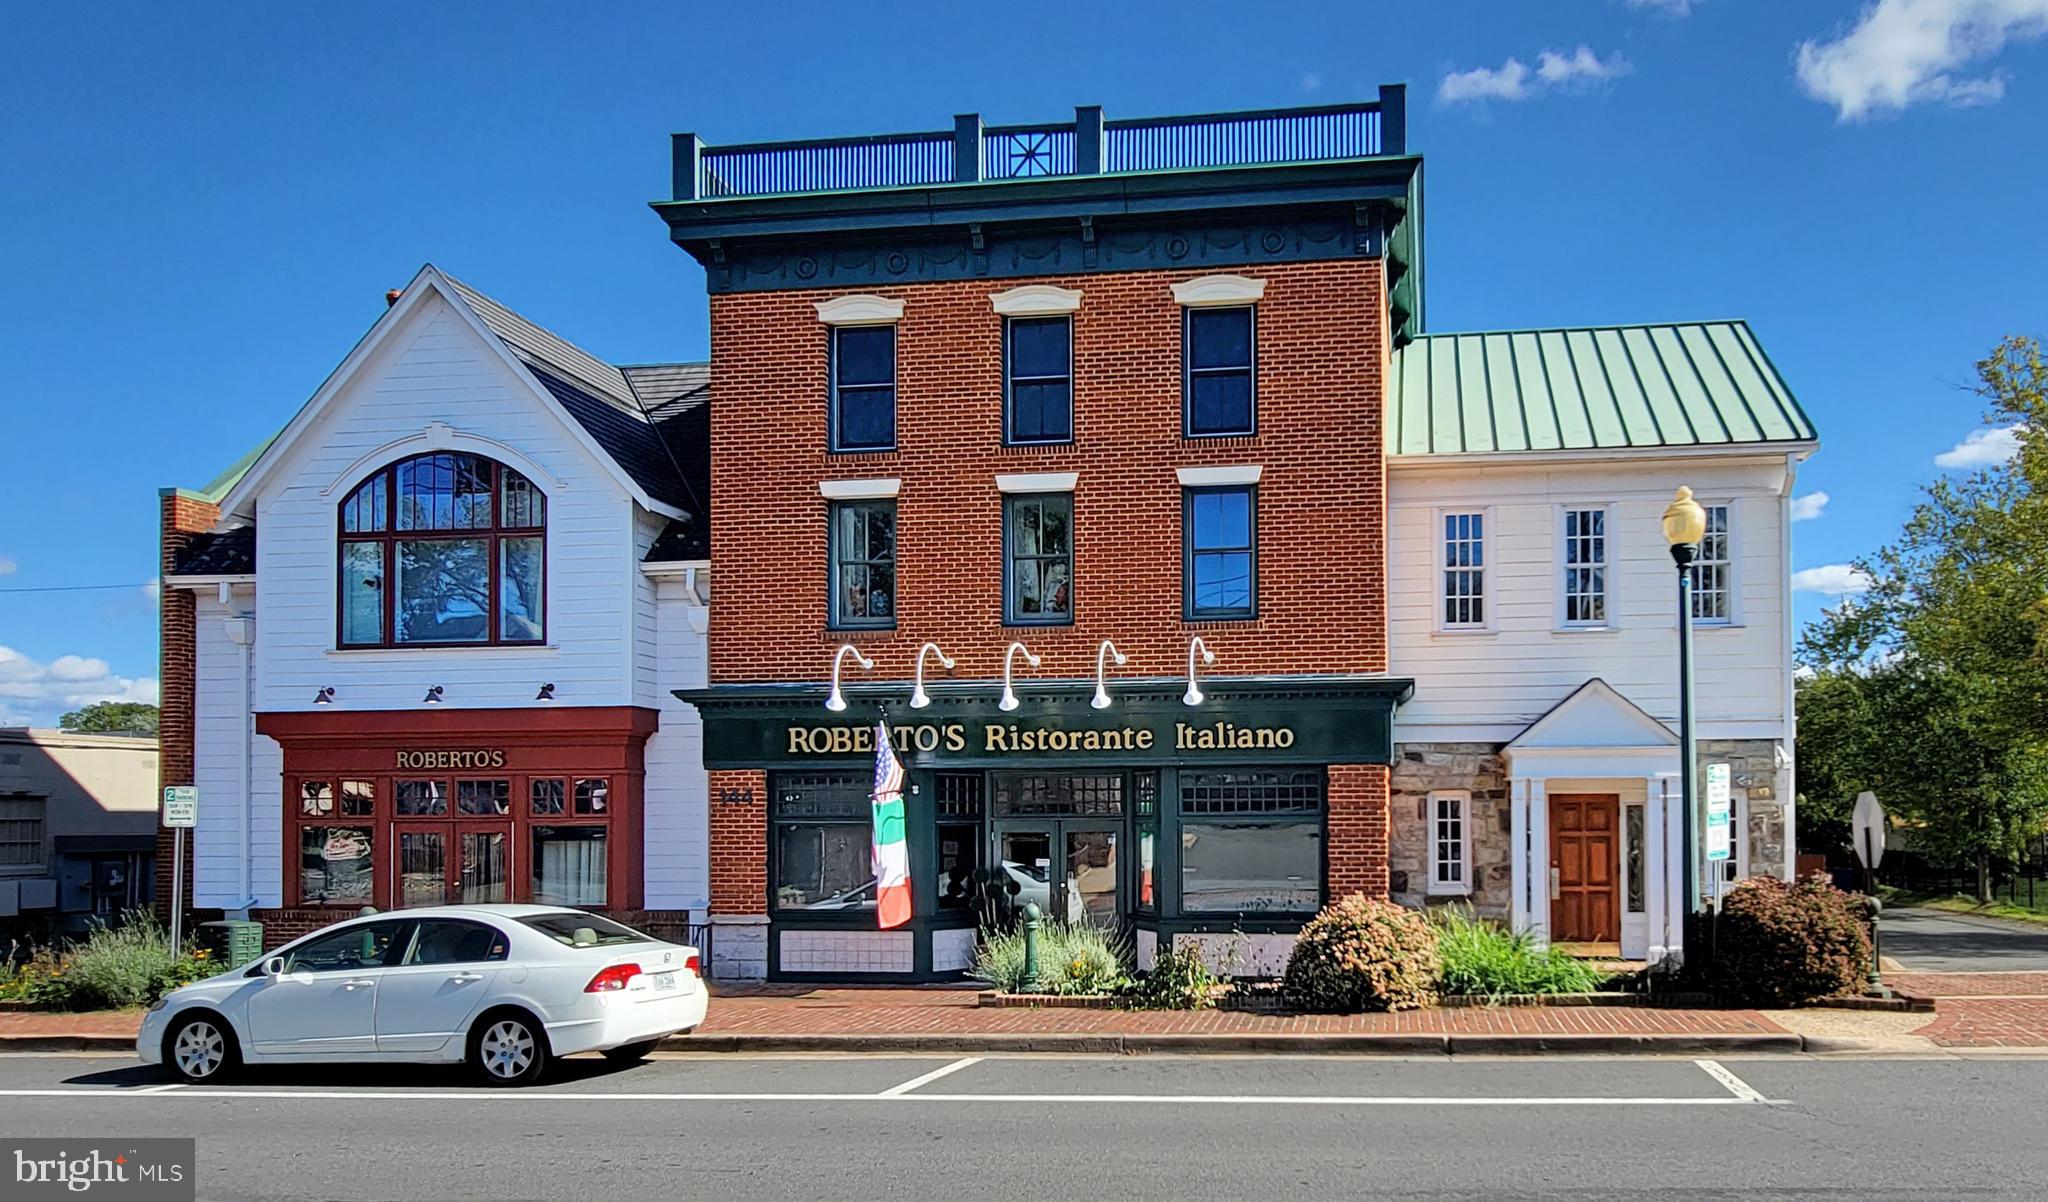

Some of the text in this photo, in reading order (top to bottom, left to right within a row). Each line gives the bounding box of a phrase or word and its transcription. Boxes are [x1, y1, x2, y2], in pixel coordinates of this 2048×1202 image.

[787, 721, 1295, 753] ROBERTO'S Ristorante Italiano
[395, 750, 504, 769] ROBERTO'S
[167, 790, 175, 800] 2
